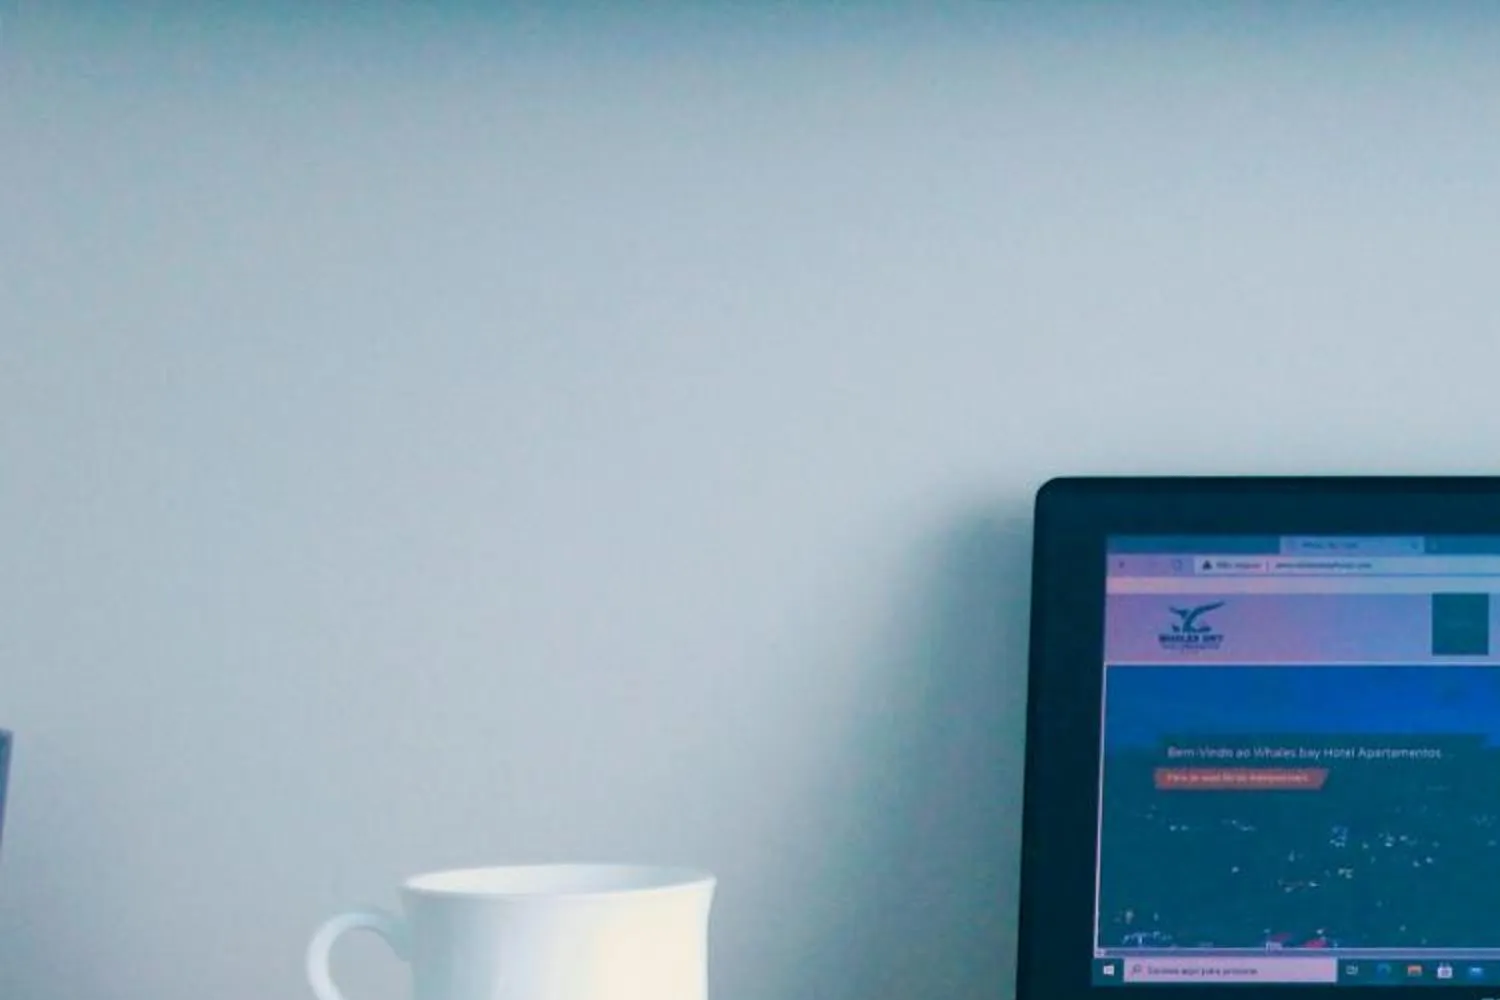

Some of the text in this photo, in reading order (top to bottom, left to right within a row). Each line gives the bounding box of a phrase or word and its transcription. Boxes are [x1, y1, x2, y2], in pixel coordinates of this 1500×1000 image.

[1253, 745, 1296, 759] Whales
[1323, 745, 1355, 759] Hotel
[1358, 746, 1441, 760] Apartamentos
